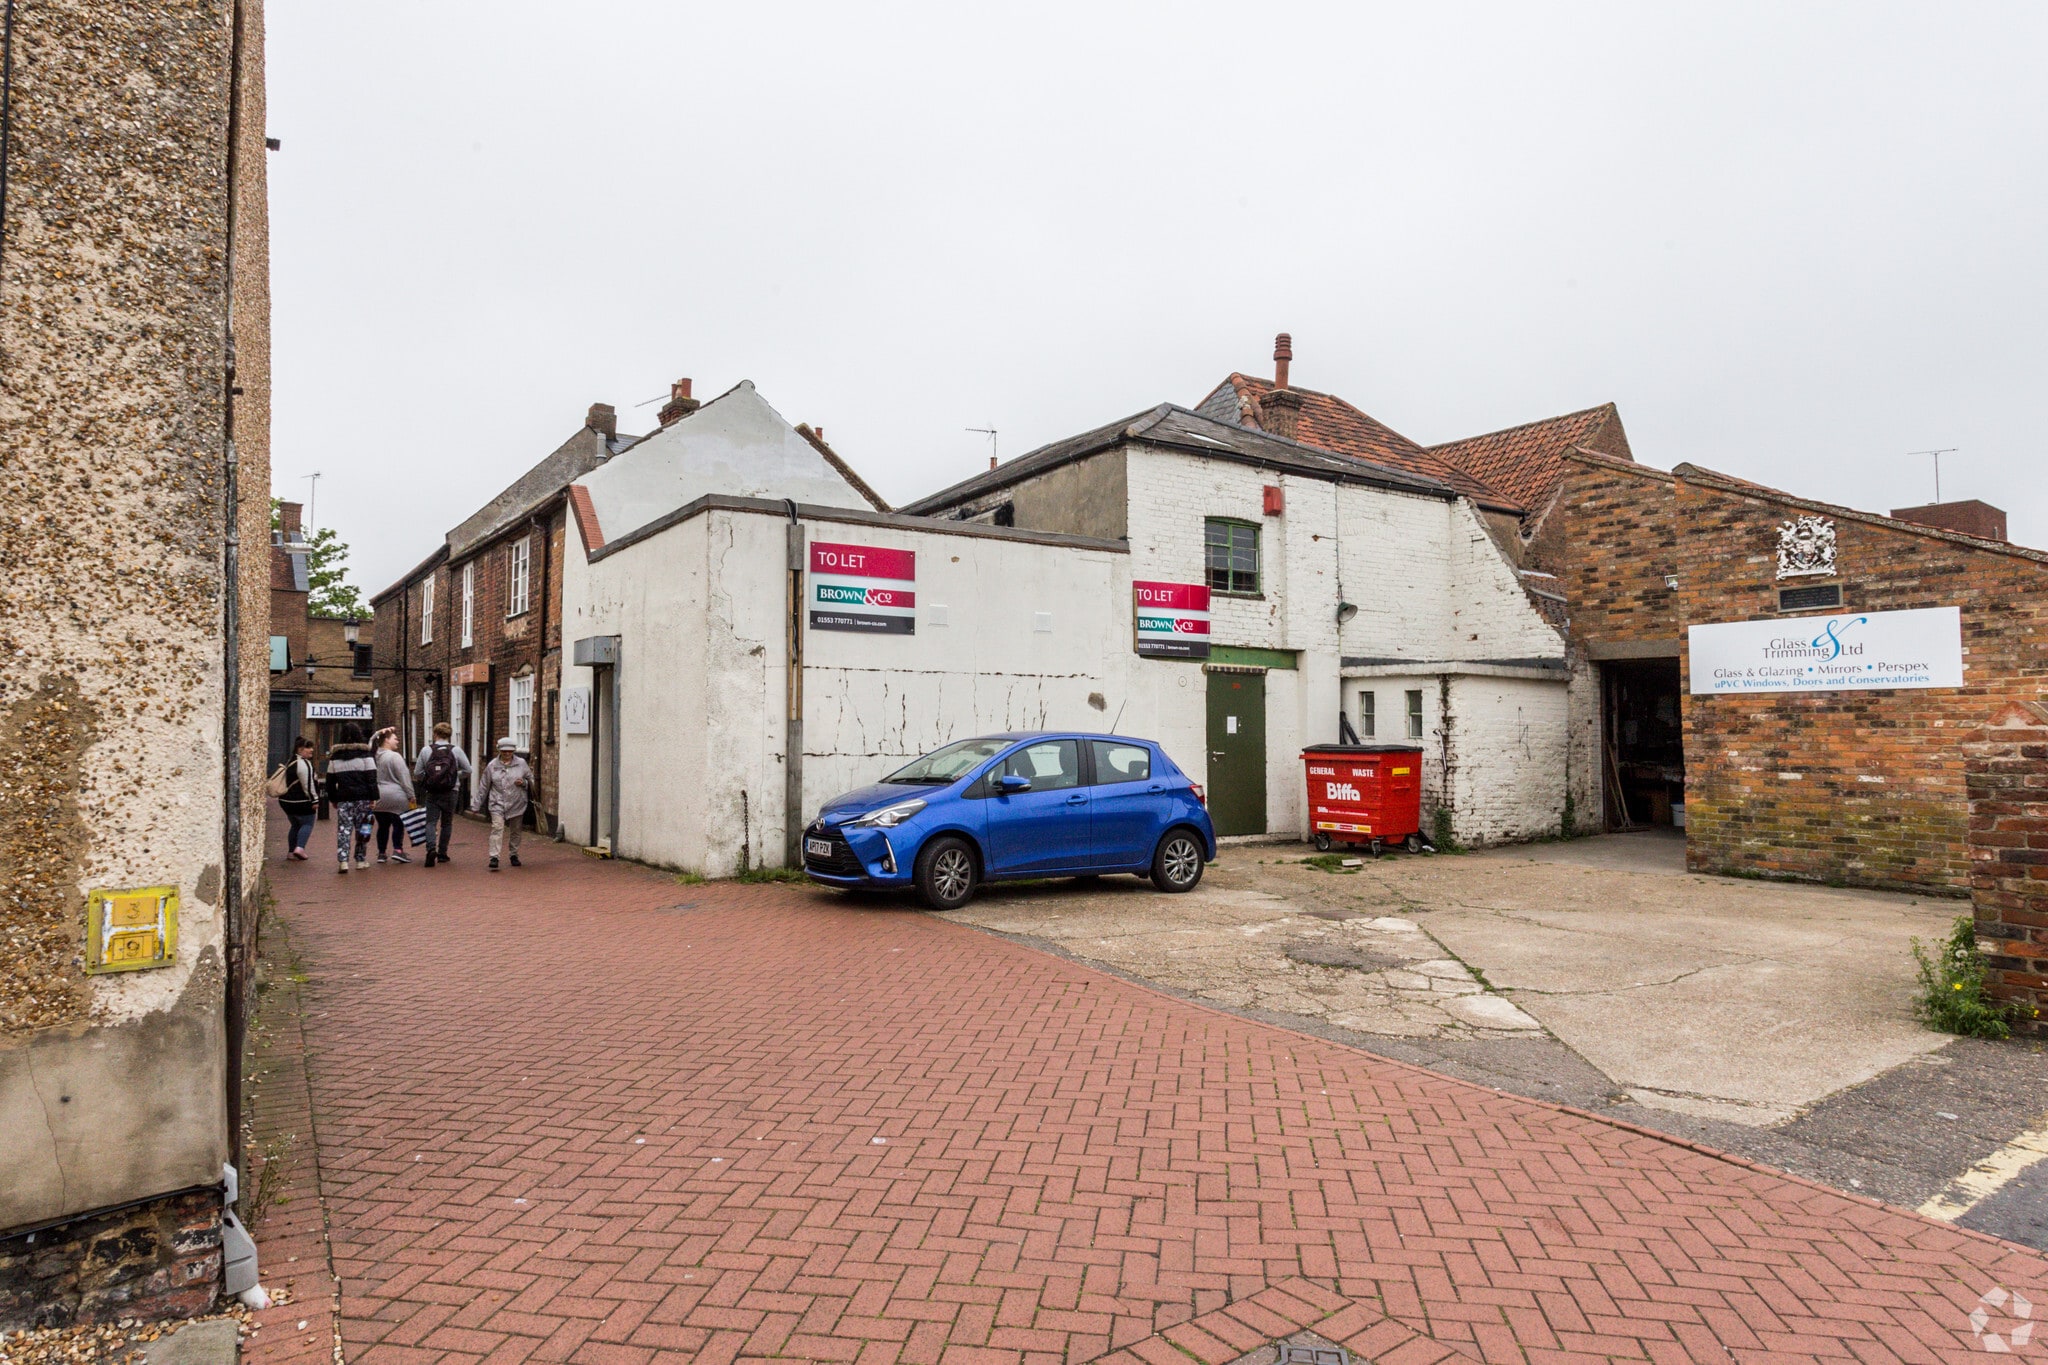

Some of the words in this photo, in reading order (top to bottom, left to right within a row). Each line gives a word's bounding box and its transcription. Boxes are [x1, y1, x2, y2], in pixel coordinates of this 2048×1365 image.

[818, 551, 837, 566] TO
[841, 553, 866, 568] LET
[1137, 588, 1152, 601] TO
[1154, 589, 1174, 602] LET
[817, 616, 834, 624] 01553
[1762, 646, 1830, 659] Trimming
[1841, 642, 1864, 656] Ltd
[1770, 637, 1807, 650] Glass
[1713, 667, 1743, 679] Glass
[1746, 667, 1755, 677] &
[1758, 665, 1804, 678] Glazing
[1817, 664, 1862, 675] Mirrors
[1877, 661, 1929, 674] Perspex
[1714, 680, 1740, 689] uPVC
[1742, 678, 1790, 688] Windows,
[1792, 677, 1823, 687] Doors
[1826, 676, 1845, 686] and
[1848, 673, 1930, 685] Conservatories
[1309, 766, 1336, 776] GENERAL
[1352, 768, 1374, 777] WASTE
[1326, 782, 1361, 801] Biffa
